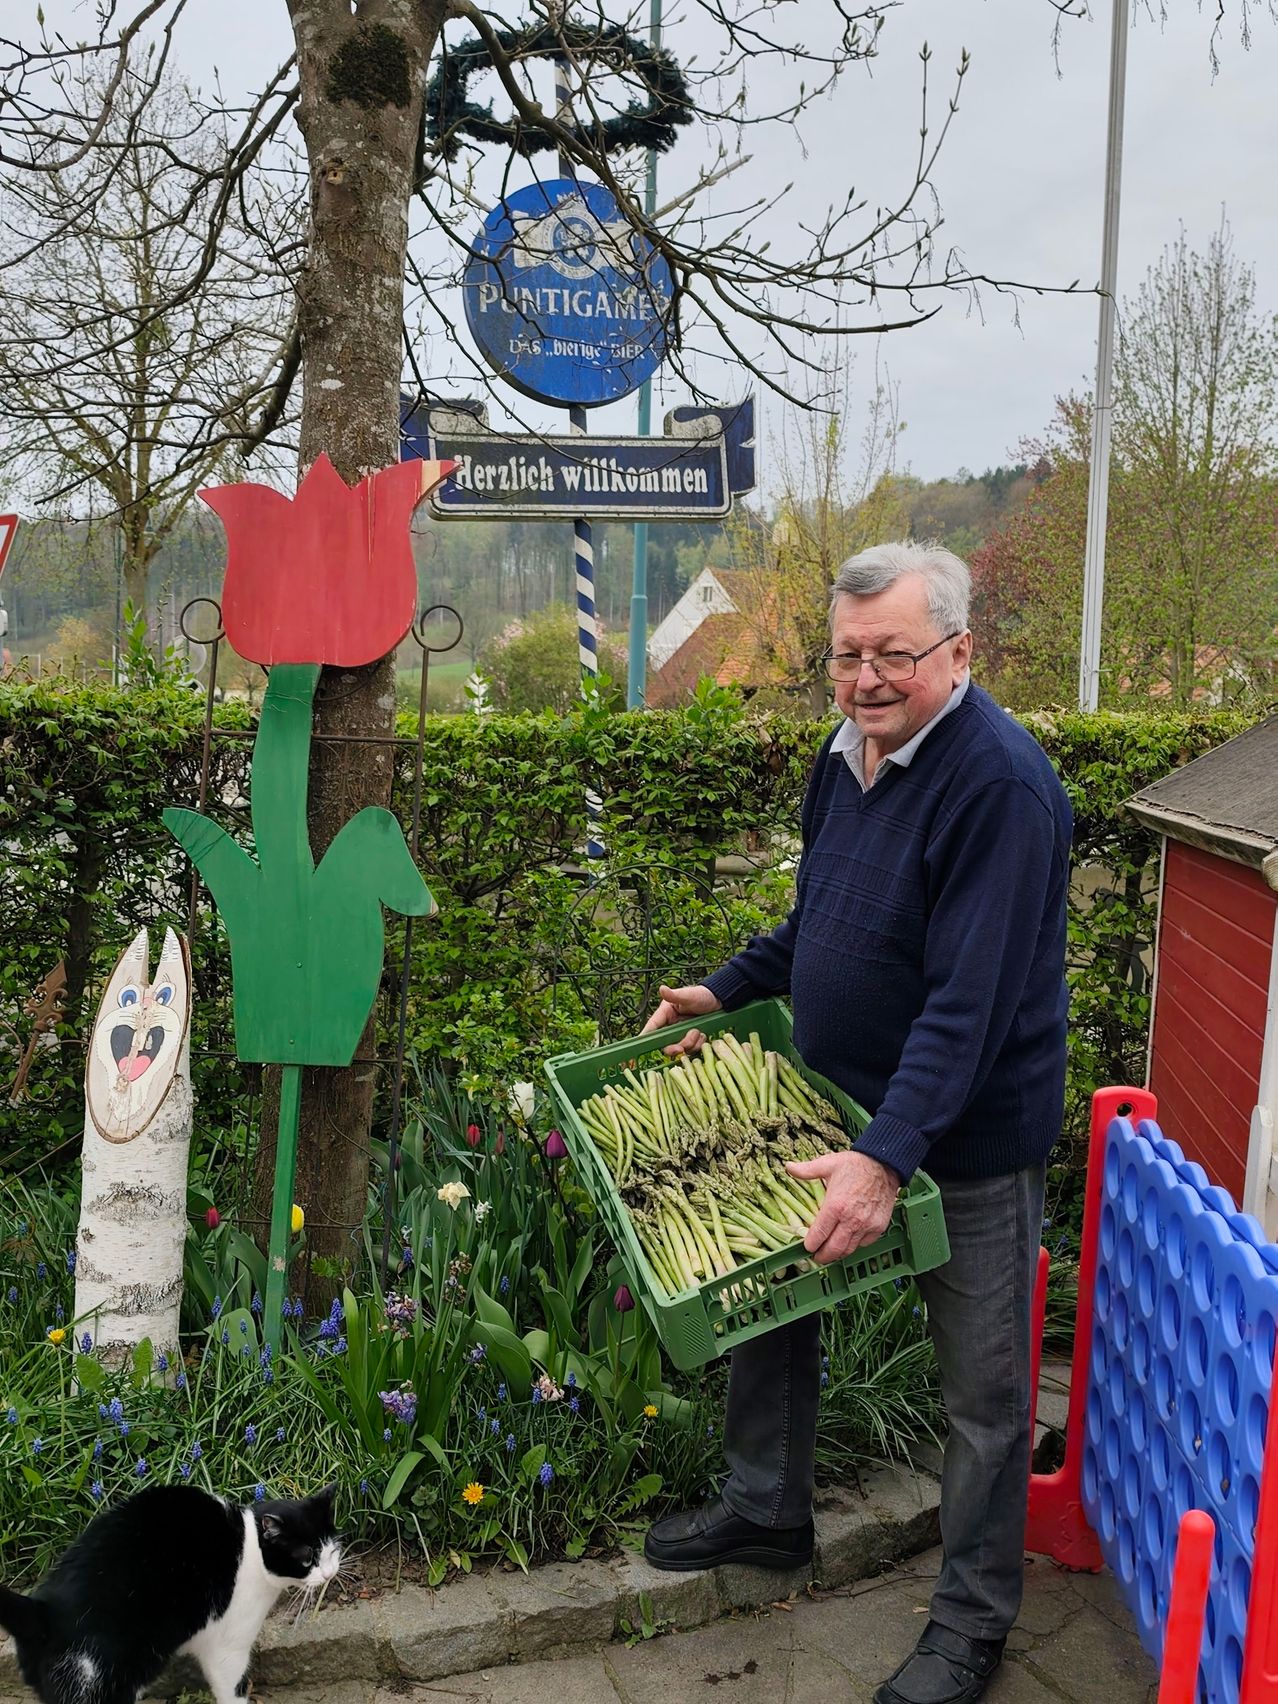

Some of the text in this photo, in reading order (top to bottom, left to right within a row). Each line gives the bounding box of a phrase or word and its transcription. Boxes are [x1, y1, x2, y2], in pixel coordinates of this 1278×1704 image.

[611, 343, 645, 359] BIER
[454, 454, 708, 494] Herzlich willkommen
